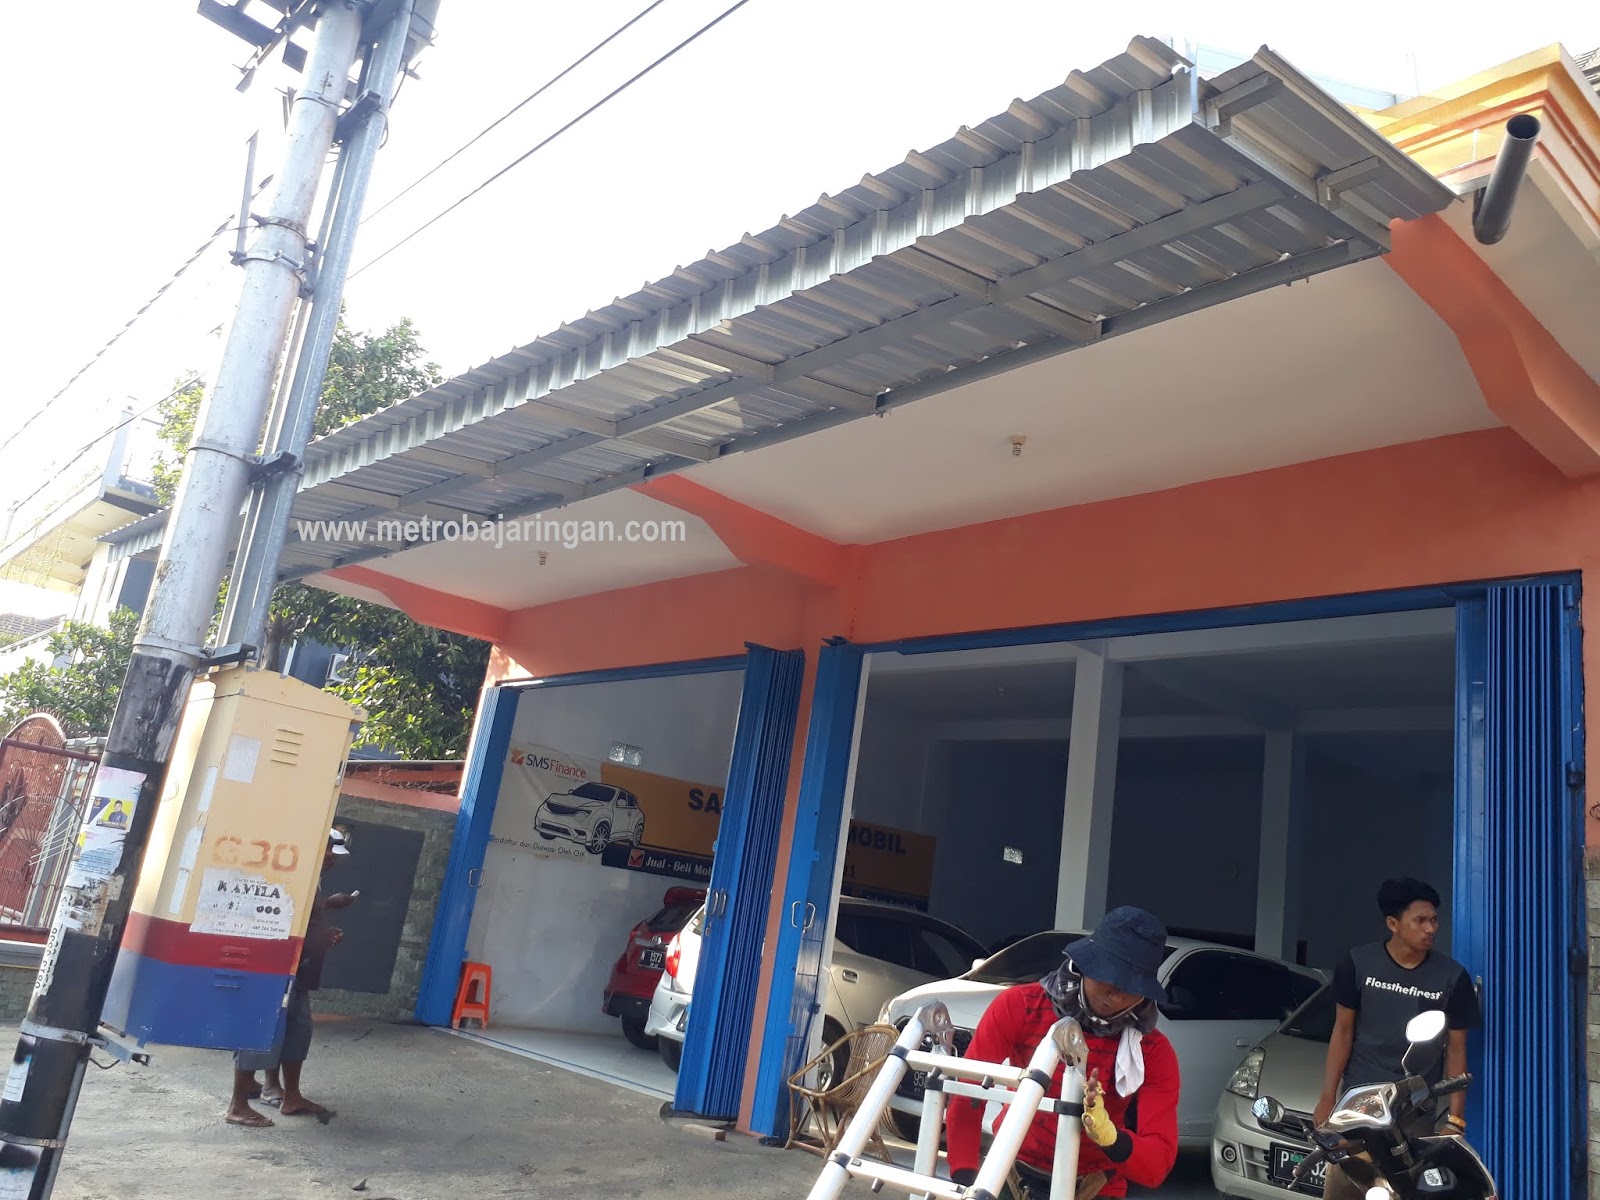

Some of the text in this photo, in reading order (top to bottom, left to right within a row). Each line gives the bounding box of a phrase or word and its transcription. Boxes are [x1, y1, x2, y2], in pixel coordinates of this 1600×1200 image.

[687, 788, 724, 815] SA
[519, 839, 532, 848] dan
[557, 846, 572, 856] Oleh
[645, 856, 667, 869] Jual
[673, 860, 692, 873] Beli
[1365, 977, 1441, 1000] Flossthefinest
[1280, 1150, 1290, 1168] P
